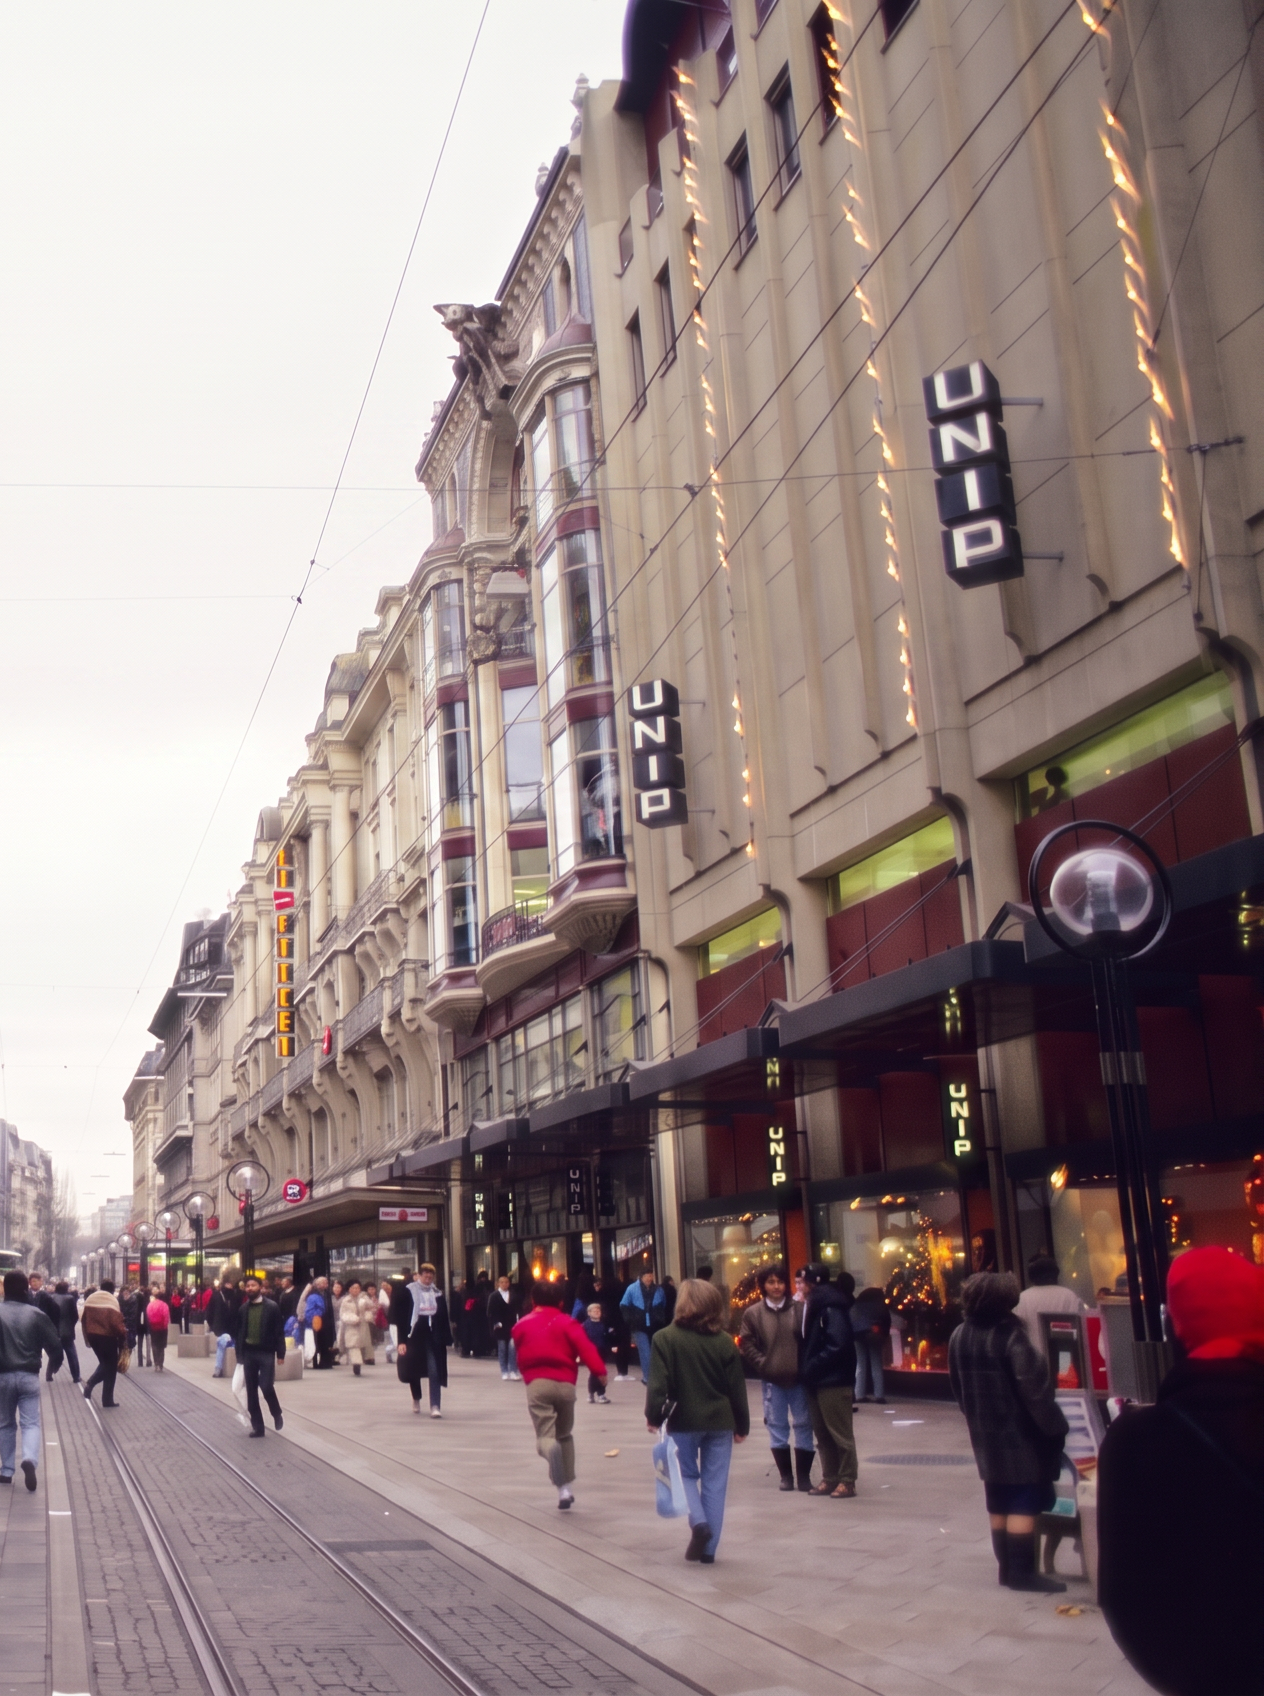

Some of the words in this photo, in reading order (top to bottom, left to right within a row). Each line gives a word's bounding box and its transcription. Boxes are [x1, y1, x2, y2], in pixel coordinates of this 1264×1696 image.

[935, 359, 1006, 568] UNIP
[633, 678, 671, 819] UNIP
[769, 1126, 786, 1186] UNIP
[949, 1083, 971, 1156] UNIP
[570, 1169, 581, 1213] UNIP
